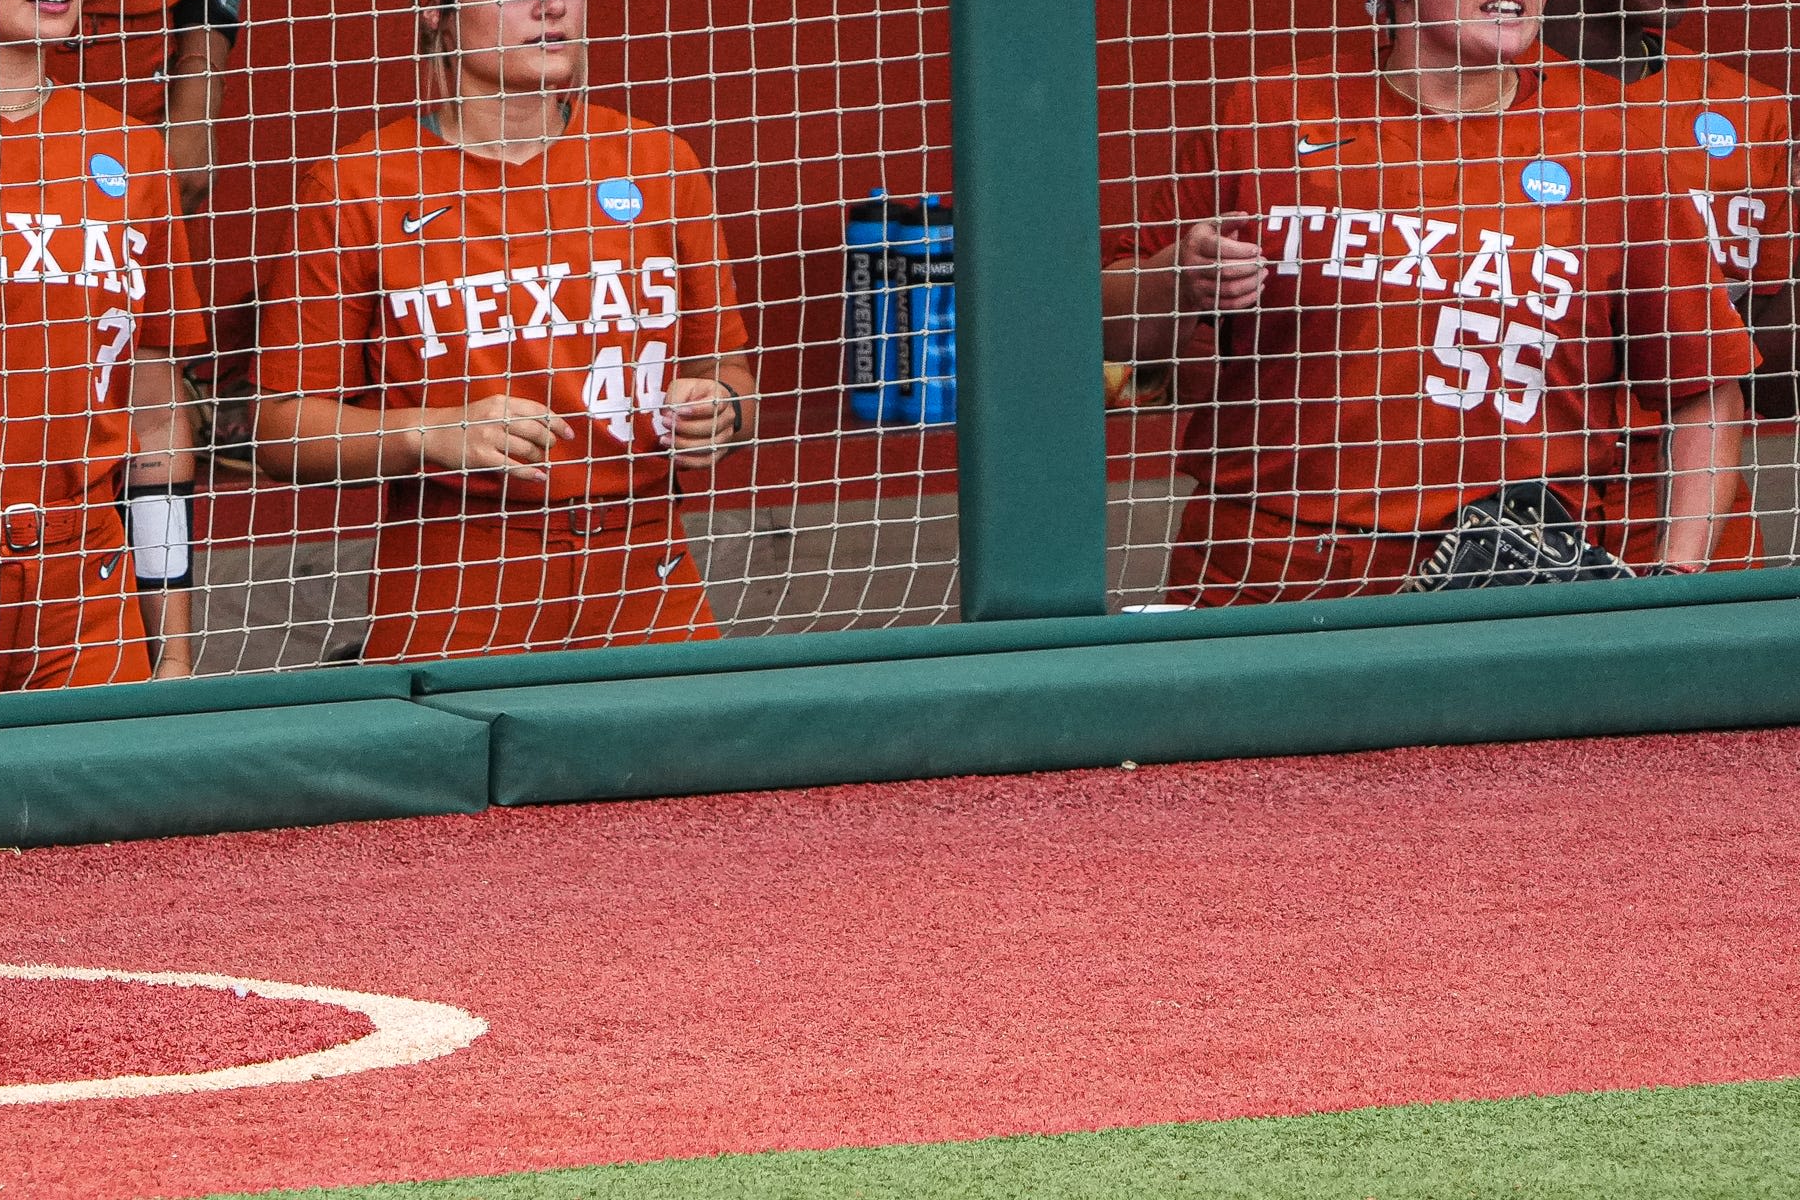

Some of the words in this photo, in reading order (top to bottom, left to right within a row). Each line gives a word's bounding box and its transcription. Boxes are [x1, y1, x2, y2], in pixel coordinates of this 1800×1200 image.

[1526, 177, 1567, 196] NCAA
[1700, 131, 1735, 147] NCAA
[603, 197, 641, 211] NCAA
[389, 256, 679, 360] TEXAS
[1266, 205, 1580, 322] TEXAS
[581, 340, 670, 443] 44
[1425, 305, 1560, 425] 55
